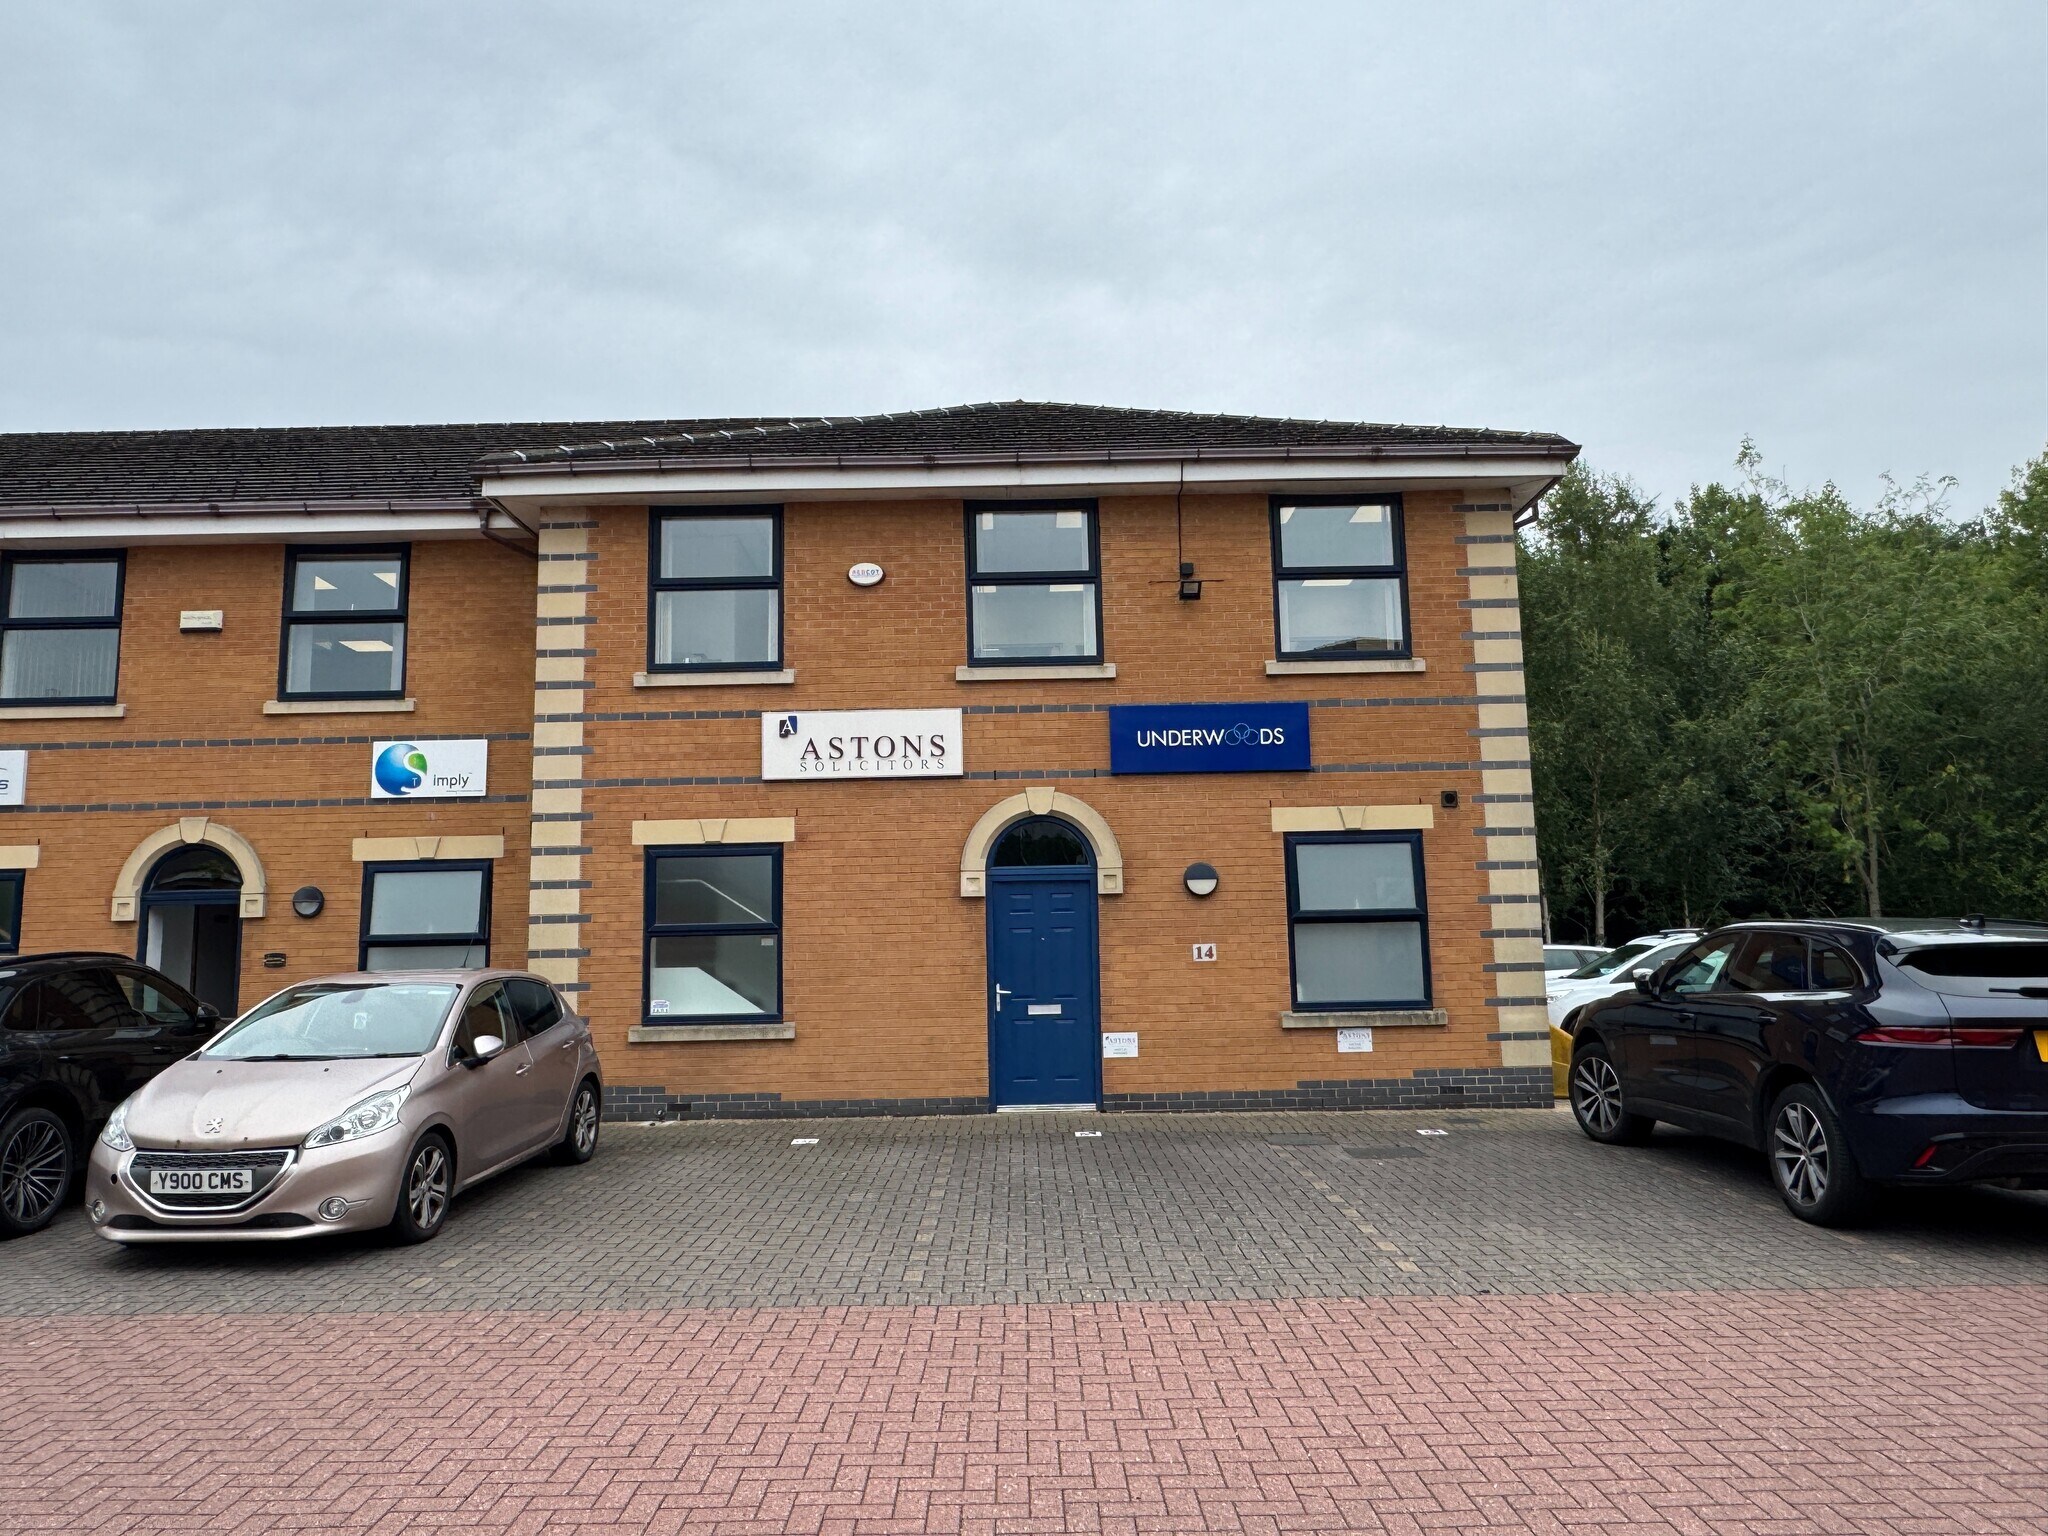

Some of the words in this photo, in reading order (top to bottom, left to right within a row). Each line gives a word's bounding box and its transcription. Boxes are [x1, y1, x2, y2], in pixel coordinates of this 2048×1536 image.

[800, 734, 945, 760] ASTONS
[799, 758, 945, 773] SOLICITORS
[1194, 945, 1215, 960] 14
[158, 1172, 203, 1190] Y900
[207, 1172, 243, 1190] CMS
